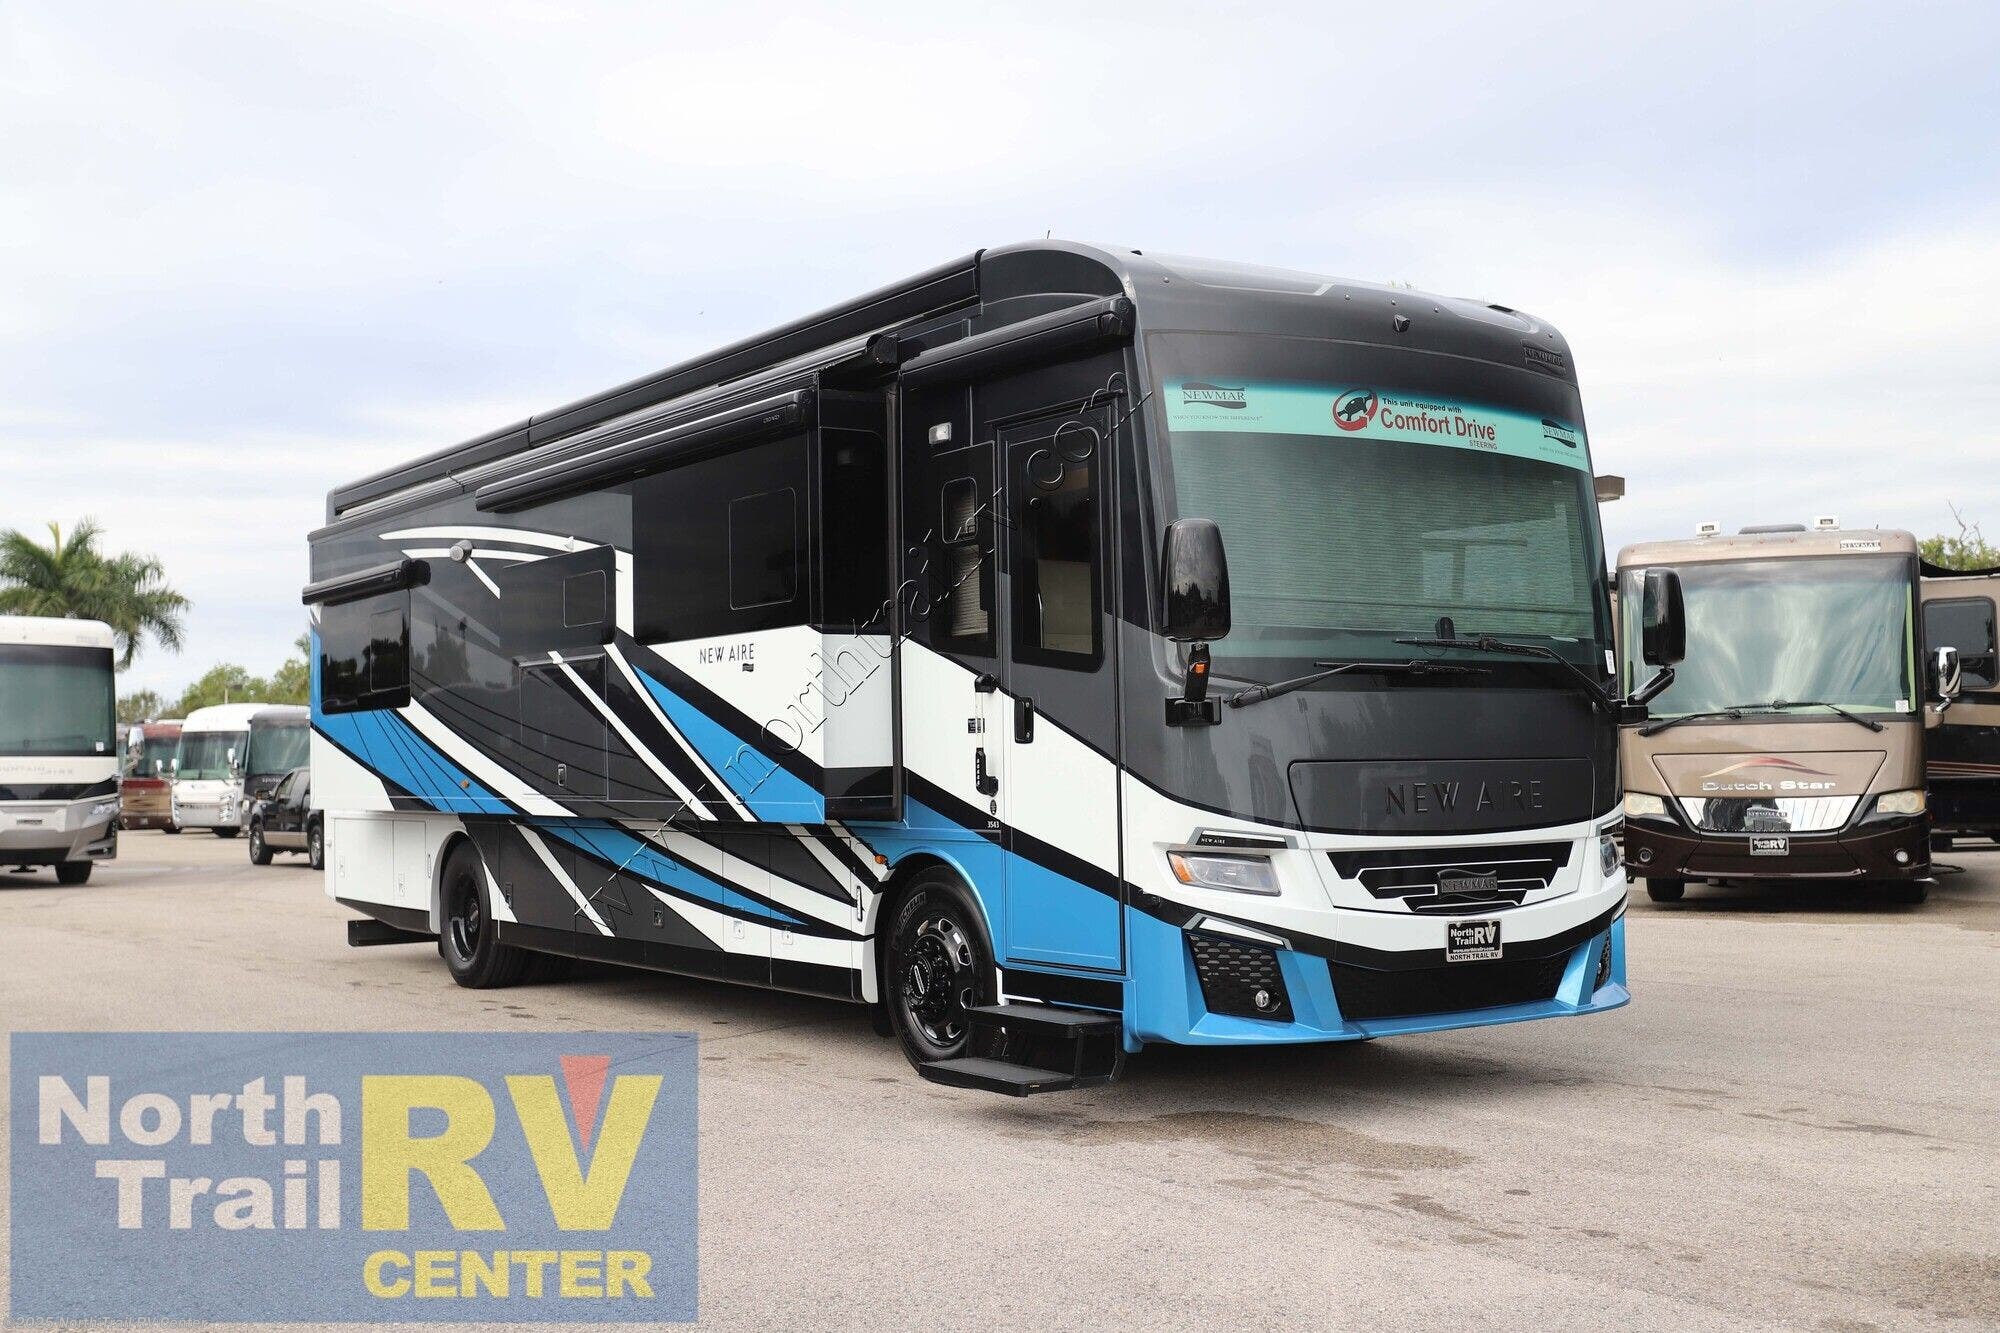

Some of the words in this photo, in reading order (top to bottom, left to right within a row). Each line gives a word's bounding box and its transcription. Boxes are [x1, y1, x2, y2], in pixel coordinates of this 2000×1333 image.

[1182, 390, 1246, 401] NEWMAR
[1382, 398, 1398, 406] This
[1400, 399, 1414, 408] unit
[1415, 402, 1446, 412] equipped
[1446, 405, 1462, 414] with
[1380, 407, 1451, 435] Comfort
[1455, 416, 1496, 441] Drive
[1542, 425, 1576, 441] NEWMAR
[1469, 439, 1498, 450] STEERING
[699, 646, 725, 665] NEW
[728, 643, 755, 662] AIRE
[1702, 781, 1773, 791] Dutch
[1780, 780, 1837, 791] Star
[1385, 781, 1460, 816] NEW
[1475, 780, 1543, 812] AIRE
[986, 820, 1000, 829] 3543
[1441, 876, 1497, 893] NEWMAR
[1451, 928, 1474, 937] North
[1474, 926, 1497, 944] RV
[1455, 937, 1474, 945] Trail
